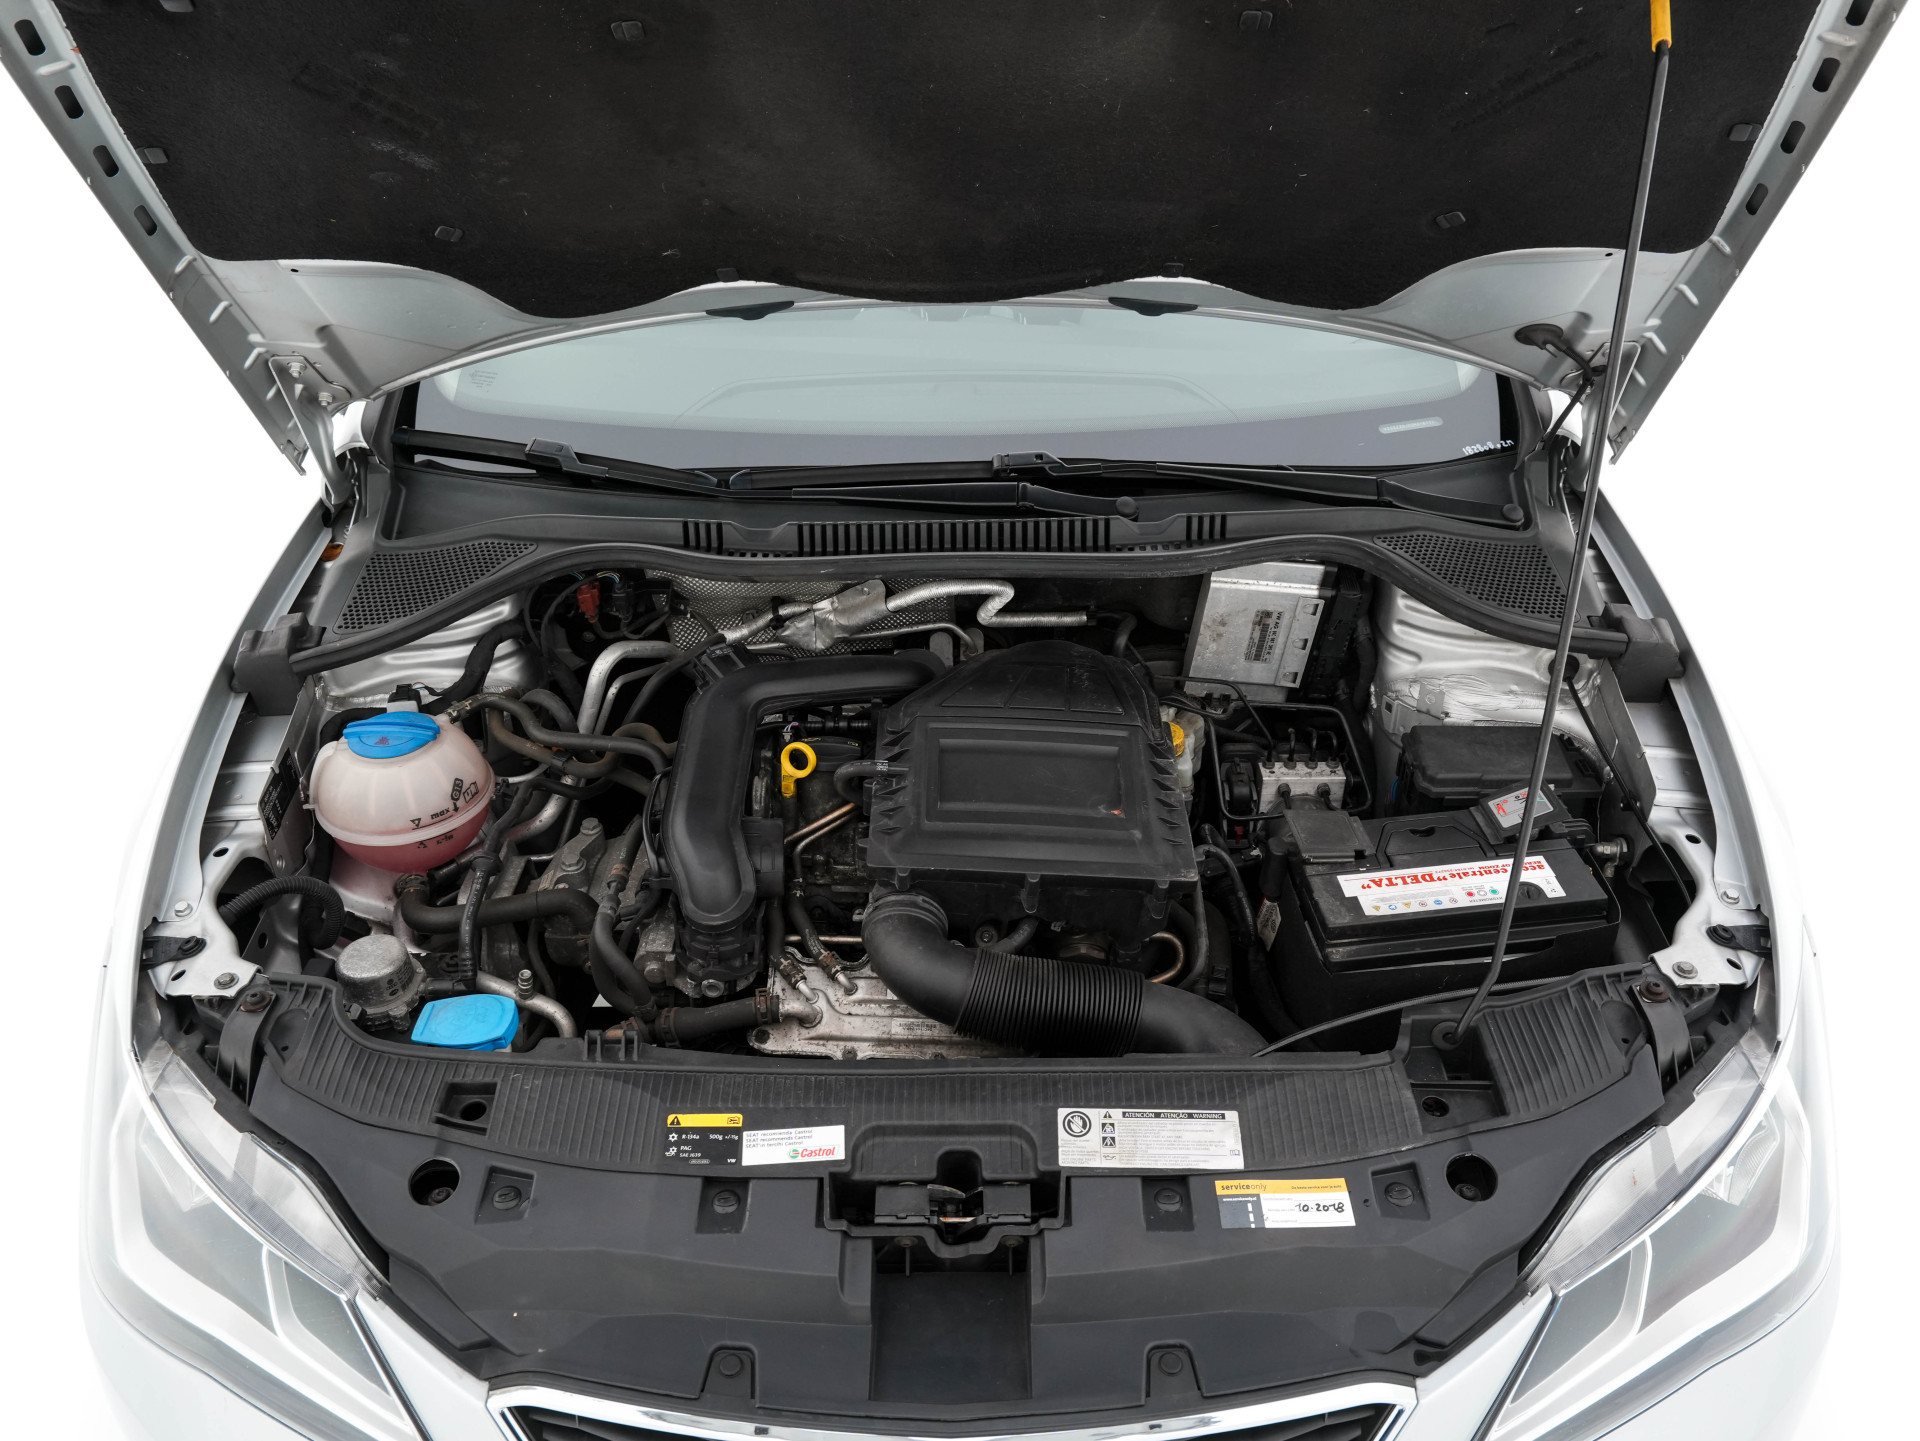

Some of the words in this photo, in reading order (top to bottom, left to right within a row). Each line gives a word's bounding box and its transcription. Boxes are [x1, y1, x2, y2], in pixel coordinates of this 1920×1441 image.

[452, 780, 462, 799] G13
[430, 807, 451, 820] max
[1449, 867, 1509, 880] centrale
[800, 1147, 836, 1158] Castrol
[1221, 1182, 1267, 1192] serviceonly
